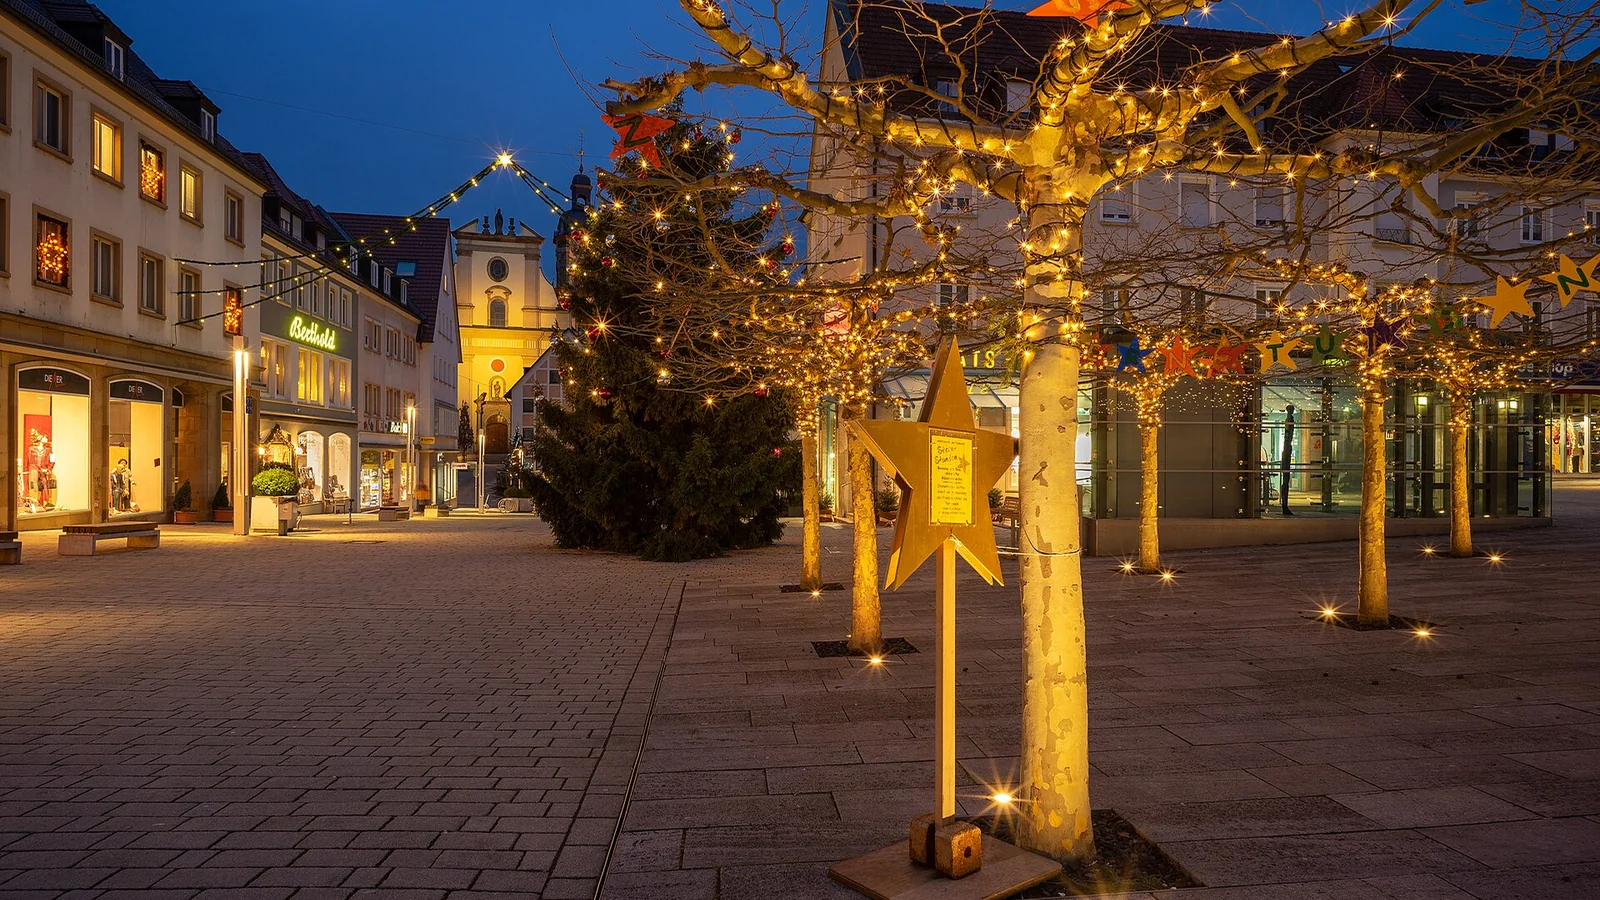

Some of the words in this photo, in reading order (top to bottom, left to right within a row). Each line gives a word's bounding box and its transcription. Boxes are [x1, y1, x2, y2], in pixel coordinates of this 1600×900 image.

[613, 115, 652, 148] Z
[1557, 268, 1589, 296] N
[289, 316, 336, 350] Berthold
[1169, 351, 1187, 370] N
[1266, 344, 1284, 362] T
[1316, 334, 1335, 354] U
